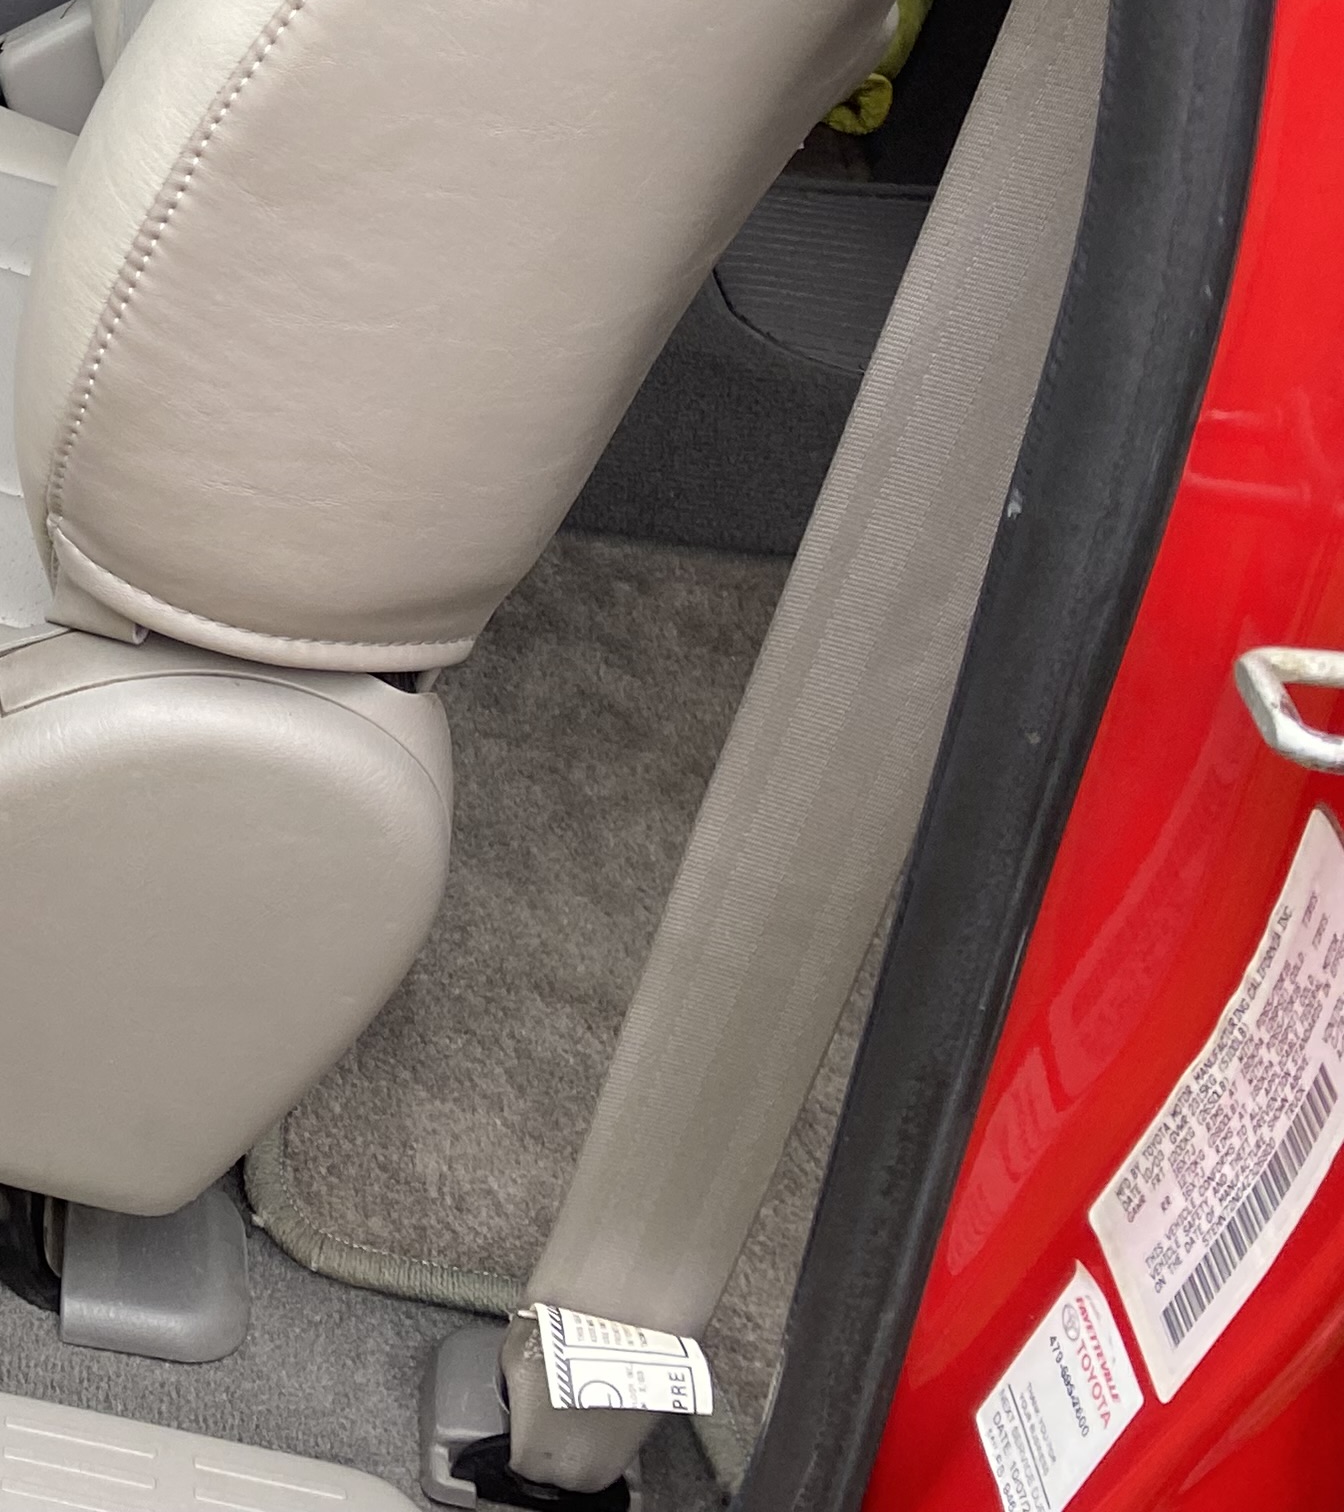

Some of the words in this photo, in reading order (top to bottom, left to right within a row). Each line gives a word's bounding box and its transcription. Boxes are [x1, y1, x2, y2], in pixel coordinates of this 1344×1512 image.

[1130, 1161, 1140, 1180] BY
[1142, 1122, 1170, 1159] TOYOTA
[1169, 1084, 1192, 1121] MOTOR
[1193, 998, 1249, 1083] MANUFACTURING
[1247, 931, 1280, 1000] CALIFORNIA
[1284, 1084, 1305, 1119] TRUCK
[1121, 1182, 1141, 1212] DATE
[1144, 1242, 1163, 1268] THIS
[1165, 1196, 1196, 1240] VEHICLE
[1198, 1143, 1234, 1196] CONFORMS
[1236, 1124, 1247, 1140] TO
[1249, 1103, 1262, 1123] ALL
[1149, 1235, 1180, 1279] VEHICLE
[1182, 1196, 1209, 1236] SAFETY
[1212, 1173, 1227, 1197] AND
[1229, 1136, 1249, 1170] THEFT
[1252, 1068, 1291, 1135] PREVENTION
[1154, 1275, 1166, 1293] ON
[1167, 1252, 1182, 1274] THE
[1183, 1223, 1203, 1253] DATE
[1205, 1205, 1214, 1223] OF
[1218, 1133, 1265, 1205] MANUFACTURE
[1267, 1095, 1288, 1131] SHOWN
[668, 1373, 687, 1409] PRE
[1076, 1297, 1119, 1400] FAYETTEVILLE
[1077, 1339, 1111, 1428] TOYOTA
[992, 1411, 1012, 1456] DATE
[1027, 1382, 1040, 1415] THANK
[1038, 1417, 1049, 1442] YOU
